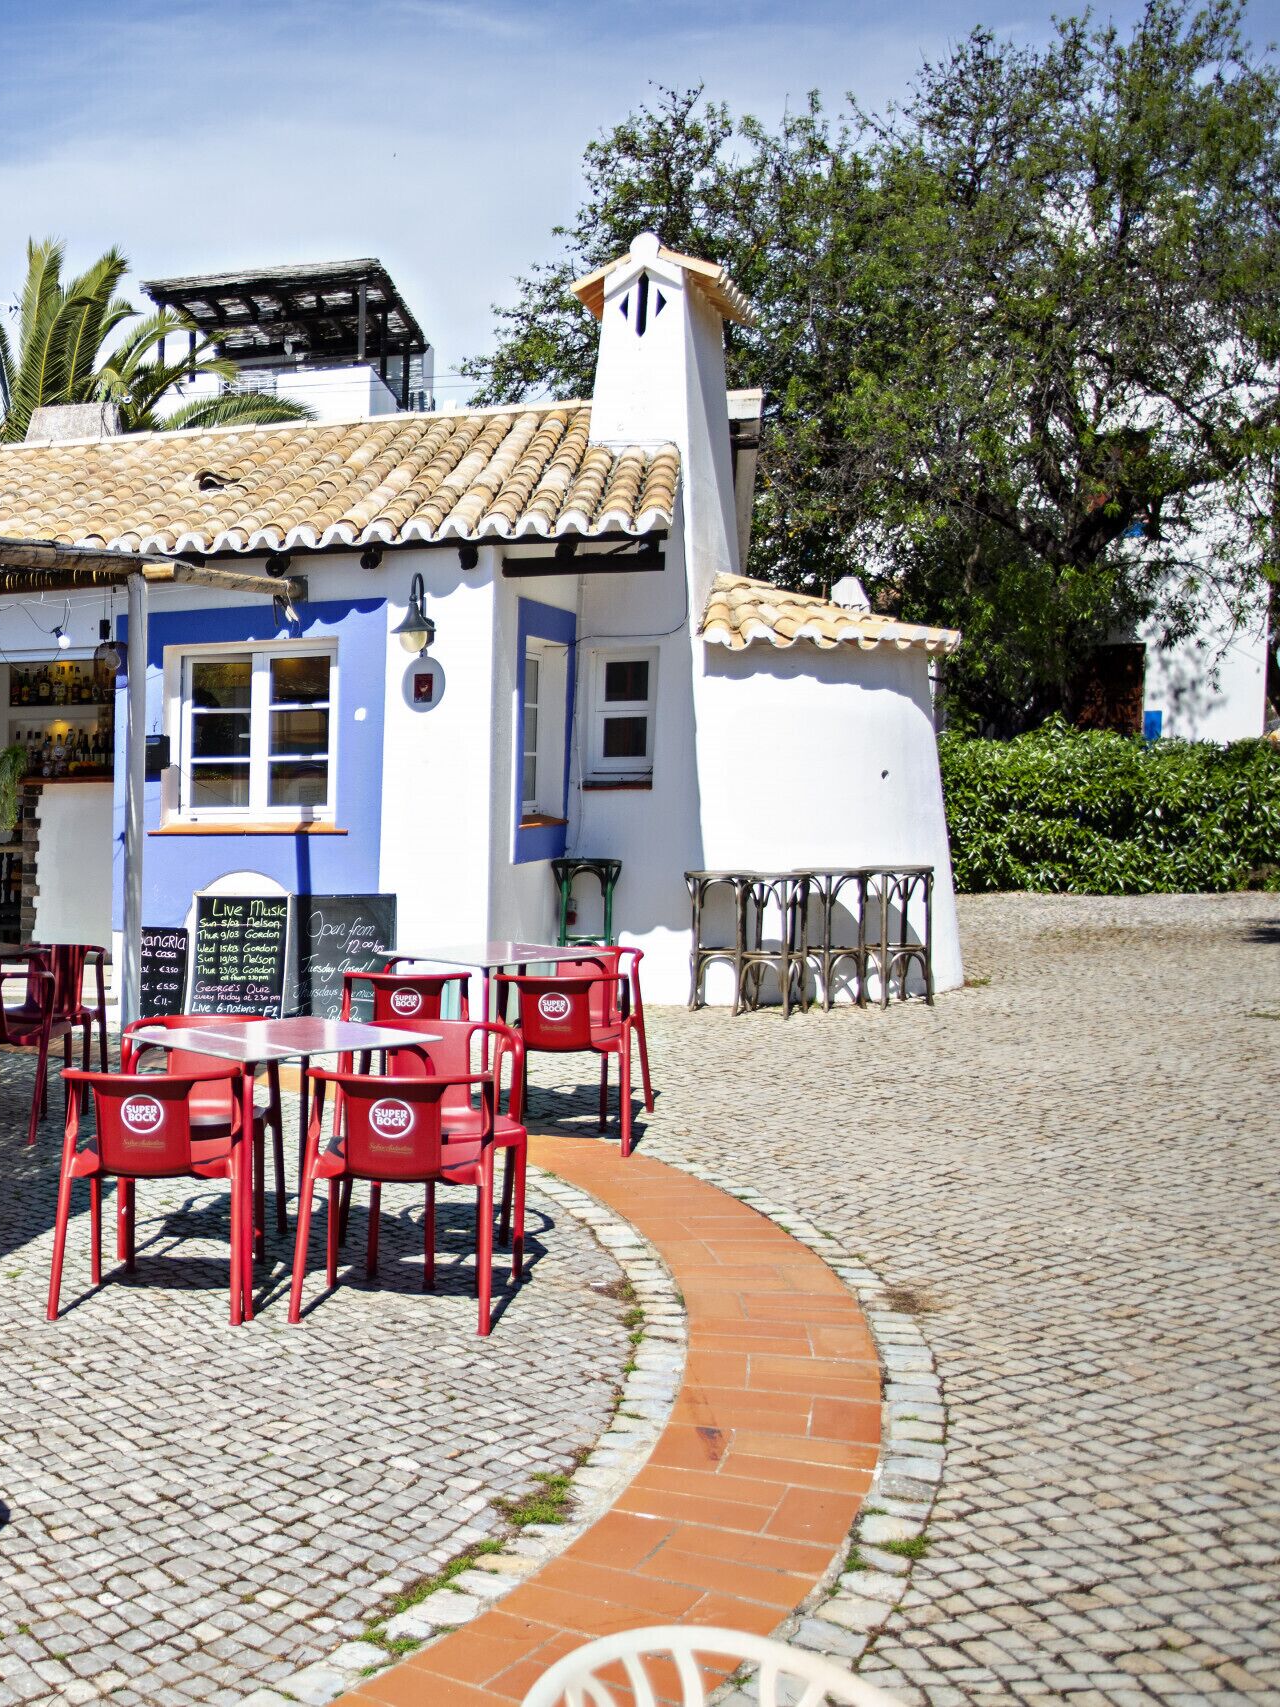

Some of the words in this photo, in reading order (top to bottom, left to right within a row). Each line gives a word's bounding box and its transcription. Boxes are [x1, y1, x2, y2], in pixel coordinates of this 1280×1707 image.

[212, 899, 243, 917] Live
[250, 900, 286, 917] Music
[199, 918, 217, 928] Sun
[221, 918, 240, 928] 5/03
[246, 917, 280, 929] Nelson
[220, 930, 239, 941] 9/03
[306, 911, 345, 945] Open
[337, 917, 375, 949] from
[197, 943, 215, 953] Wed
[220, 943, 239, 953] 15/03
[155, 950, 177, 958] casa
[198, 954, 214, 963] Sun
[220, 954, 239, 965] 19/03
[243, 954, 276, 964] Nelson
[219, 966, 239, 975] 23/03
[301, 954, 336, 982] Tuesday
[246, 983, 270, 994] Quiz
[269, 995, 281, 1004] pm
[191, 1002, 211, 1013] Live
[263, 1005, 279, 1017] F1
[126, 1104, 158, 1114] SUPER
[374, 1108, 408, 1118] SUPER
[128, 1112, 157, 1122] BOCK
[376, 1116, 406, 1127] BOCK
